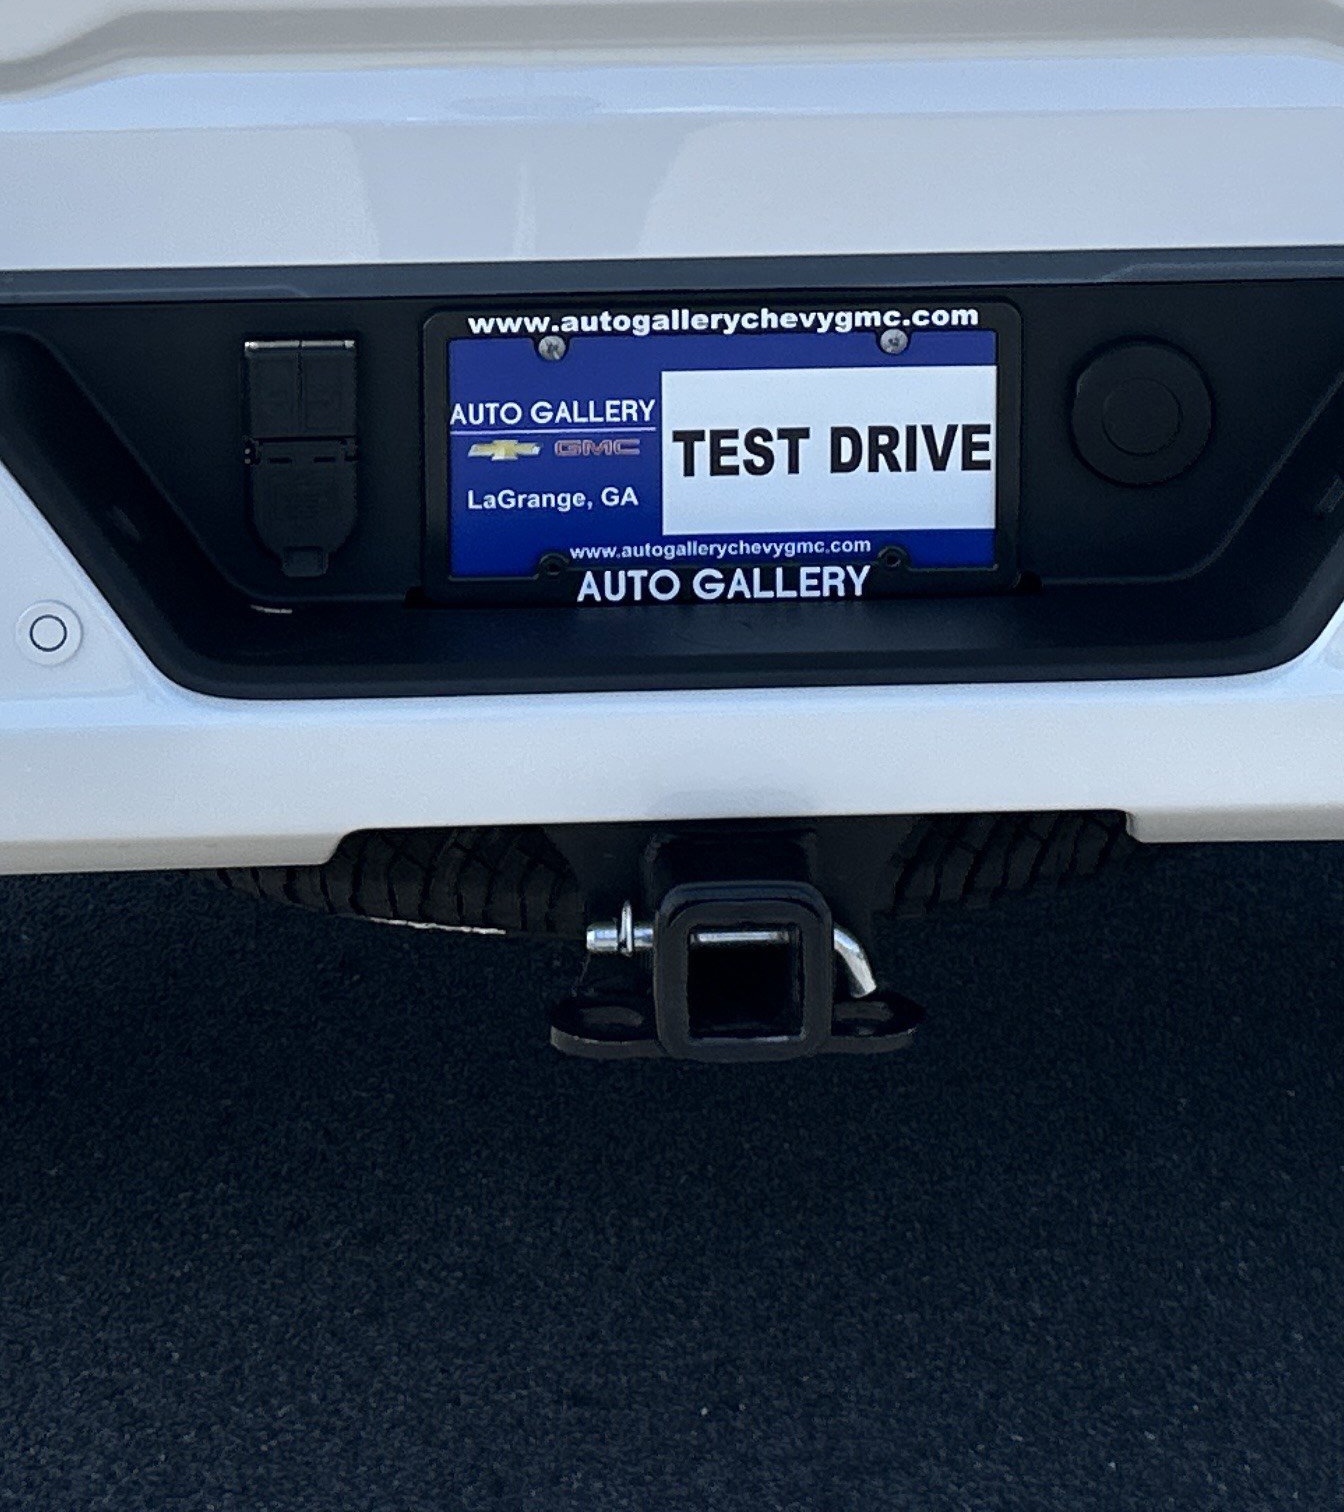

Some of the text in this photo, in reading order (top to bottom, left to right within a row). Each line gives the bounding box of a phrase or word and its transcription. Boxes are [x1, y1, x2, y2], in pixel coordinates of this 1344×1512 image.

[468, 306, 980, 335] www.autogallerychevygmc.com
[450, 399, 656, 426] AUTO GALLERY
[554, 439, 640, 456] GMC
[672, 423, 993, 477] TEST DRIVE
[467, 487, 639, 512] LaGrange, GA
[569, 536, 872, 561] www.autogallerychevygmc.com
[576, 565, 872, 602] AUTO GALLERY
